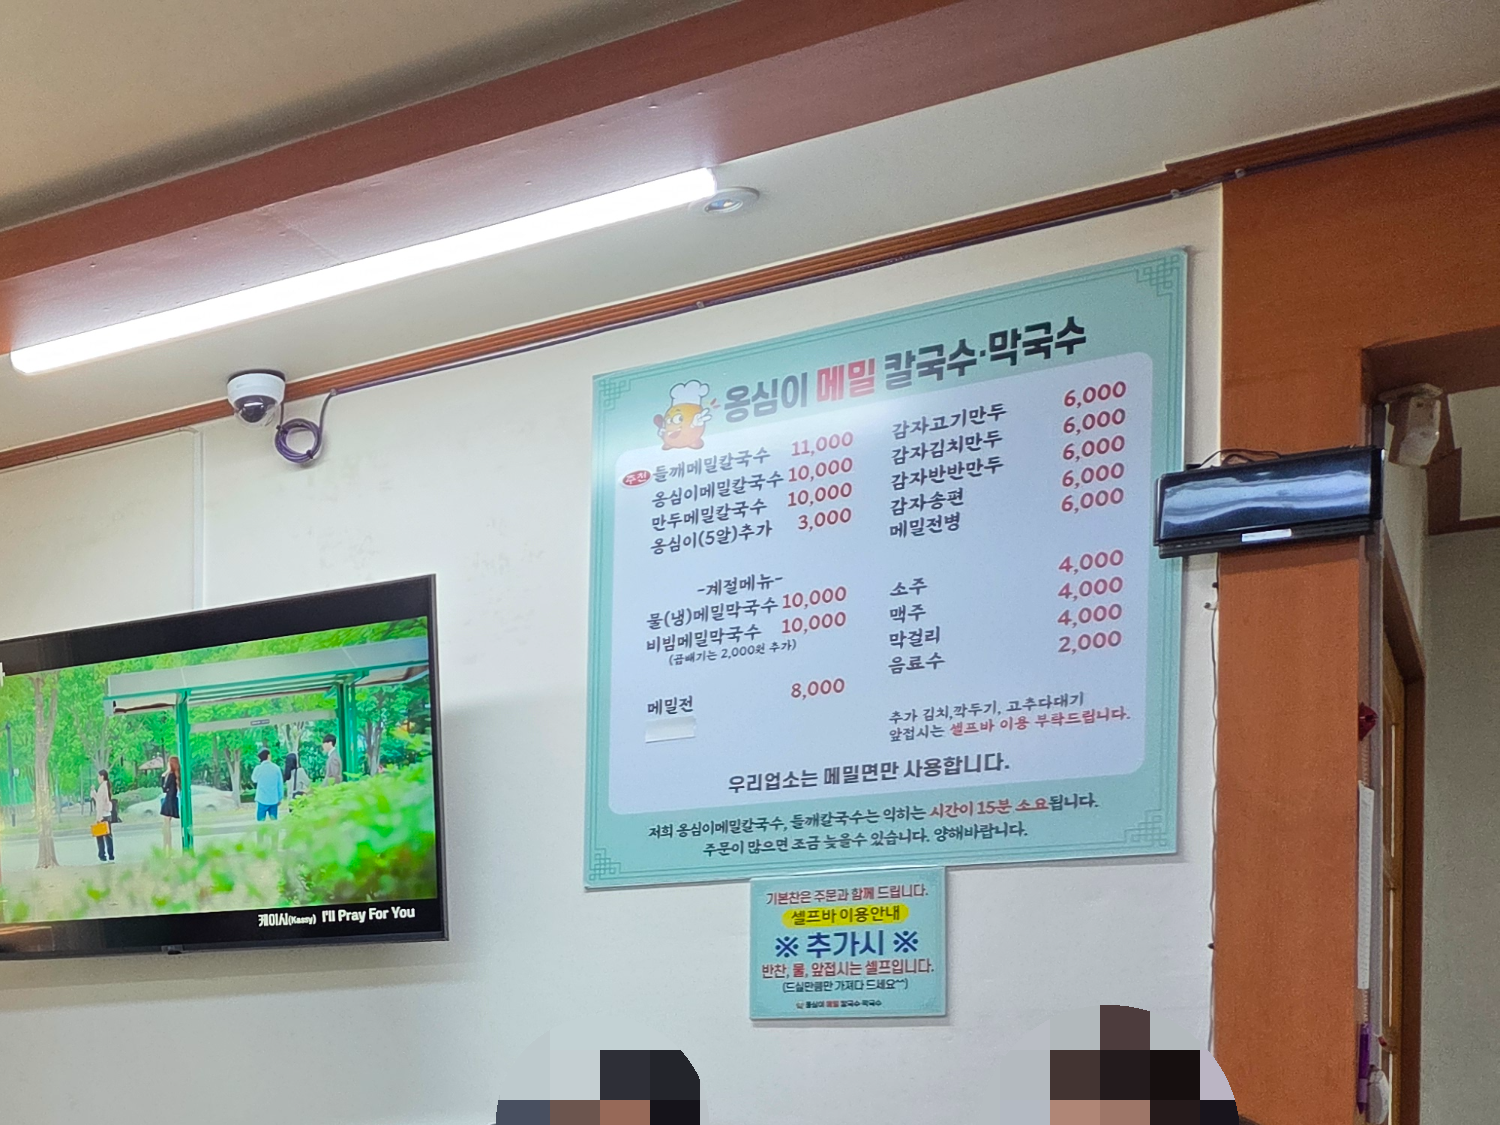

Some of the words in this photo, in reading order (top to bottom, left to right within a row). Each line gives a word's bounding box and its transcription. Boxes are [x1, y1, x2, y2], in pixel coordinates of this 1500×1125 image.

[724, 372, 808, 423] 옹심이
[816, 358, 876, 402] 메밀
[1064, 381, 1127, 408] 6,000
[892, 402, 1007, 440] 감자고기만두
[1063, 408, 1126, 435] 6,000
[791, 432, 854, 457] 11,000
[891, 430, 1003, 465] 감자김치만두
[1062, 435, 1125, 462] 6,000
[652, 446, 771, 483] 들깨메밀칼국수
[788, 457, 853, 482] 10,000
[890, 456, 1004, 491] 감자반반만두
[1062, 462, 1125, 489] 6,000
[651, 470, 784, 508] 옹심이메밀칼국수
[787, 482, 852, 507] 10,000
[890, 487, 965, 516] 감자송편
[1061, 487, 1124, 514] 6,000
[651, 498, 768, 532] 만두메밀칼국수
[797, 507, 852, 532] 3,000
[889, 511, 961, 538] 메밀전병
[651, 519, 773, 555] 옹심이(5알)추가
[1058, 549, 1124, 575] 4,000
[697, 573, 783, 596] -계절메뉴-
[782, 586, 847, 609] 10,000
[889, 577, 928, 597] 소주
[1057, 576, 1124, 602] 4,000
[646, 597, 779, 630] 물(냉)메밀막국수
[781, 611, 846, 635] 10,000
[889, 603, 926, 624] 맥주
[1057, 603, 1123, 629] 4,000
[646, 623, 762, 653] 비빔메밀막국수
[721, 644, 766, 660] 2,000원
[768, 638, 797, 653] 추가)
[889, 625, 941, 650] 막걸리
[1057, 630, 1122, 655] 2,000
[888, 652, 946, 675] 음료수
[790, 678, 845, 700] 8,000
[647, 695, 694, 716] 메밀전
[888, 708, 918, 725] 추가
[1006, 691, 1084, 713] 고추다대기
[888, 724, 945, 742] 앞접시는
[949, 718, 995, 737] 셀프바
[1000, 715, 1030, 731] 이용
[1034, 706, 1131, 729] 부탁드립니다.
[728, 769, 819, 794] 우리업소는
[823, 761, 900, 786] 메밀면만
[903, 752, 1011, 779] 사용합니다.
[648, 824, 673, 839] 저희
[676, 816, 788, 838] 옹심이메밀칼국수,
[789, 809, 880, 830] 들깨칼국수는
[882, 805, 927, 823] 익히는
[929, 801, 974, 819] 시간이
[977, 798, 1012, 815] 15분
[1015, 792, 1100, 812] 소요됩니다.
[702, 840, 744, 857] 주문이
[747, 837, 789, 855] 많으면
[791, 835, 821, 851] 조금
[823, 832, 868, 850] 늦을수
[870, 827, 931, 847] 있습니다.
[934, 820, 1029, 843] 양해바랍니다.
[766, 891, 811, 906] 기본찬은
[814, 888, 849, 903] 주문과
[851, 886, 875, 901] 함께
[877, 884, 929, 899] 드립니다.
[322, 910, 336, 923] I'll
[338, 909, 367, 923] Pray
[369, 907, 389, 920] For
[391, 906, 416, 919] You
[790, 908, 837, 927] 셀프바
[840, 905, 900, 924] 이용안내
[806, 930, 885, 959] 추가시
[762, 963, 789, 979] 반찬,
[792, 962, 808, 978] 물,
[811, 961, 862, 978] 앞접시는
[864, 958, 935, 976] 셀프입니다.
